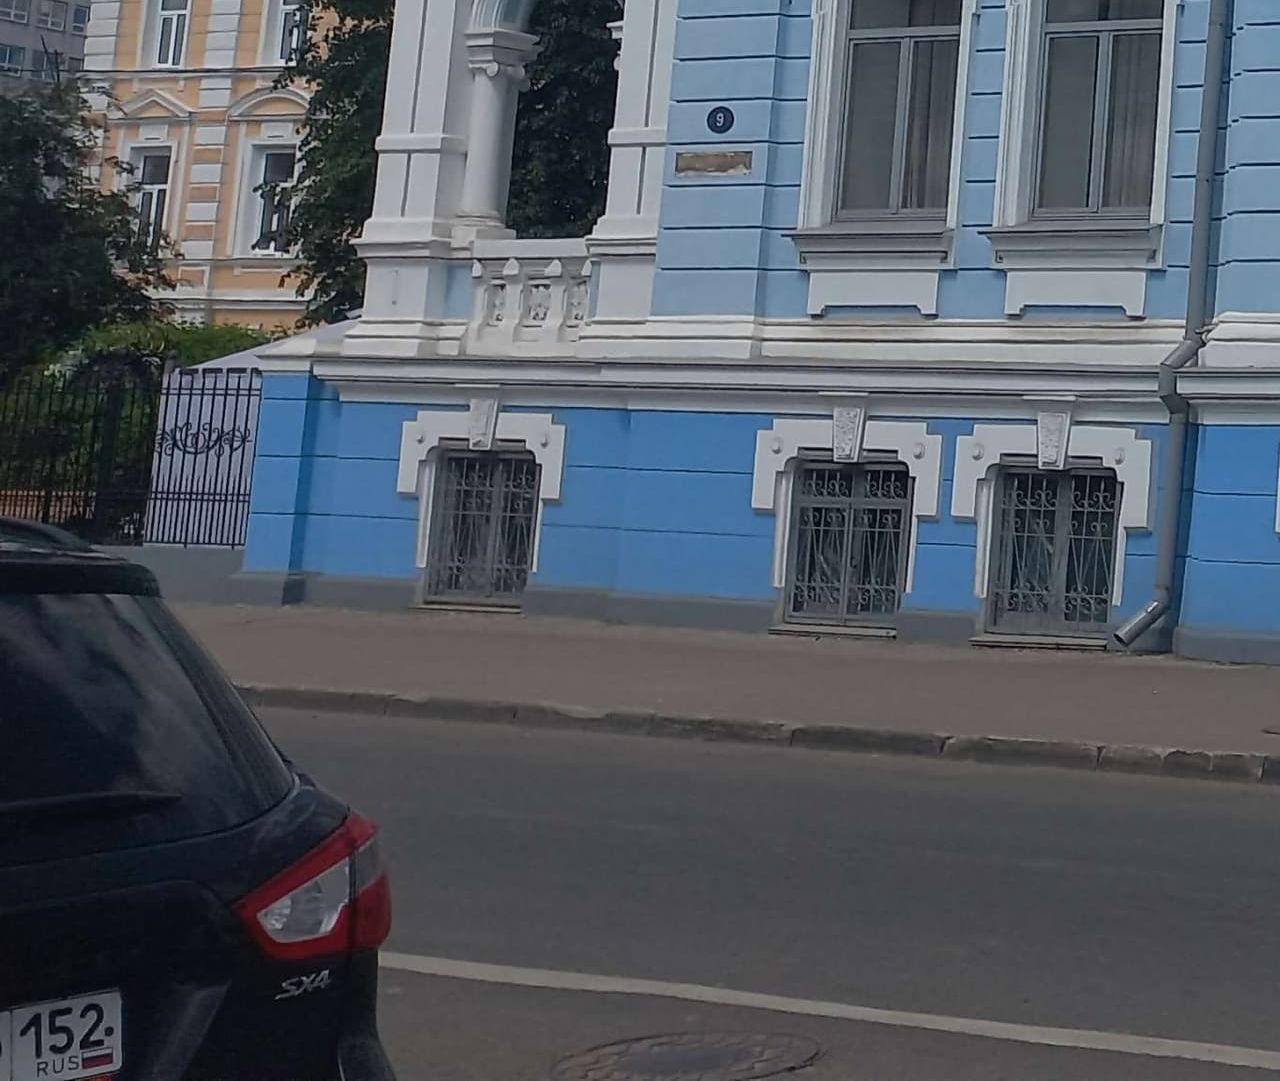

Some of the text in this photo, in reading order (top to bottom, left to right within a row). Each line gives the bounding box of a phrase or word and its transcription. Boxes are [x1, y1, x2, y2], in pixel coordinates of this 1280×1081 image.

[716, 113, 724, 127] 9
[275, 969, 331, 1000] SX4
[20, 1003, 104, 1059] 152
[37, 1055, 80, 1078] RUS
